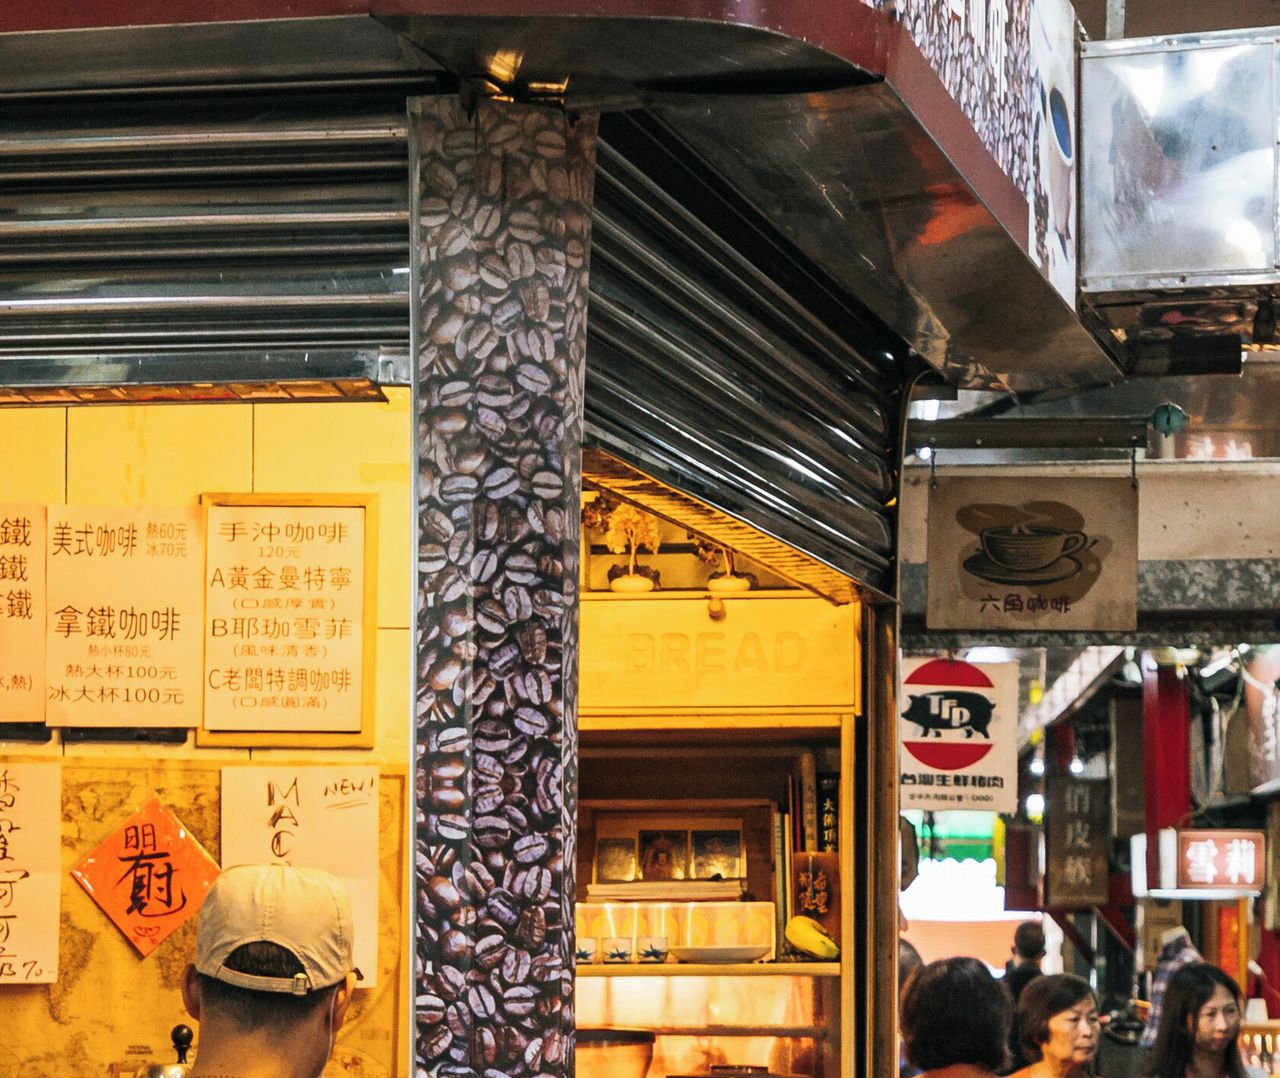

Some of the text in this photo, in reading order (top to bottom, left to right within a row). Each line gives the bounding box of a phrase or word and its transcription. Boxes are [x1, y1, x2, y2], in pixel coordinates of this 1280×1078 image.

[52, 522, 139, 557] 美式咖啡
[218, 521, 349, 543] 手沖咖啡
[257, 545, 301, 559] 120元
[211, 565, 352, 591] A黃金曼特寧
[54, 605, 181, 641] 拿鐵咖啡
[625, 631, 808, 673] BREAD
[66, 664, 178, 680] 熱大杯100元
[209, 668, 352, 693] C老闆特調咖啡
[48, 685, 185, 704] 冰大杯100元
[324, 777, 374, 797] NEW!
